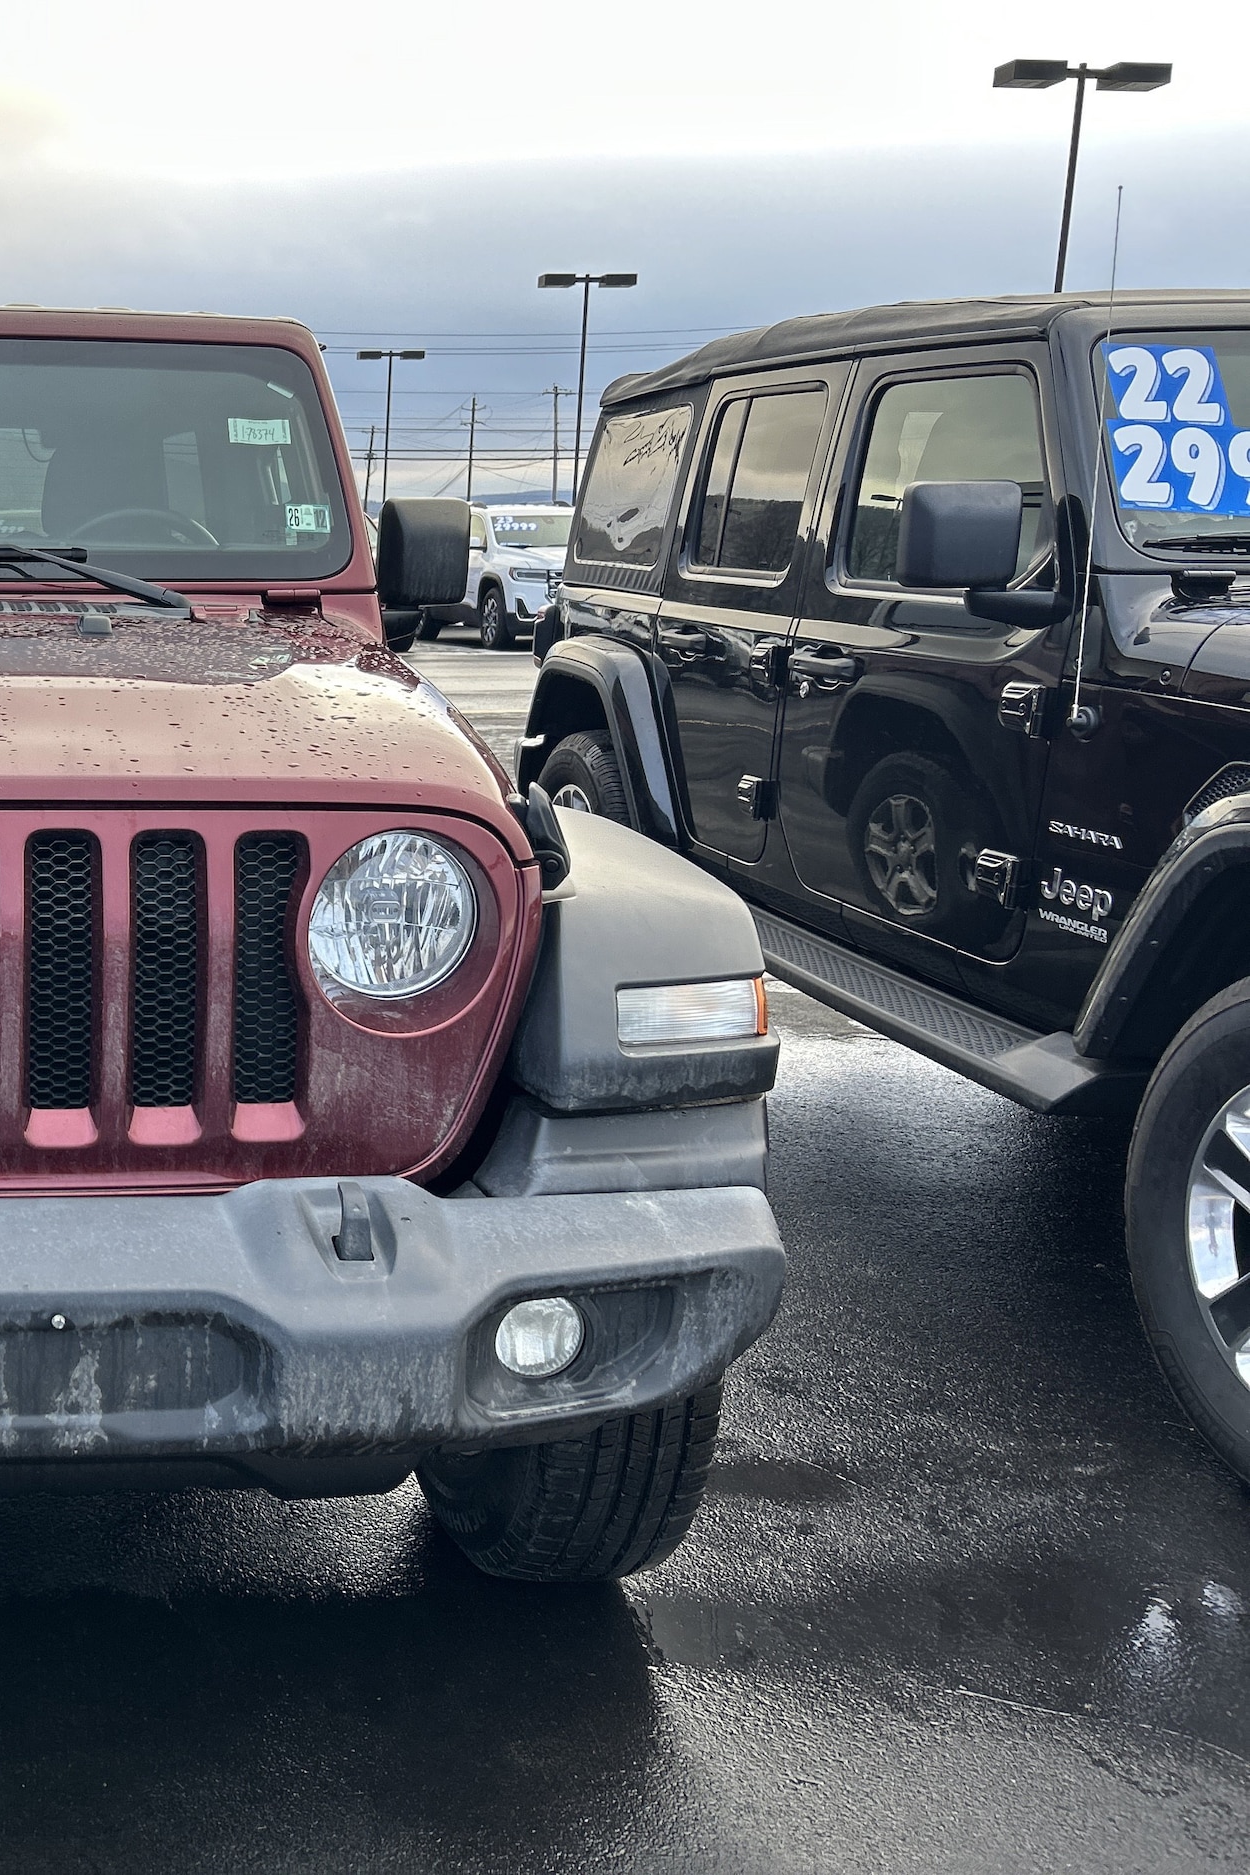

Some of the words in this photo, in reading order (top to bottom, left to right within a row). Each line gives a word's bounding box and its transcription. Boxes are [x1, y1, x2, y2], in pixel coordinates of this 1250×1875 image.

[1108, 346, 1225, 427] 22
[288, 508, 300, 527] 26
[494, 522, 537, 532] 29999
[1048, 820, 1124, 850] SAHARA
[1040, 867, 1114, 922] Jeep
[1038, 907, 1108, 938] WRANGLER
[1058, 922, 1109, 944] UNLIMITED
